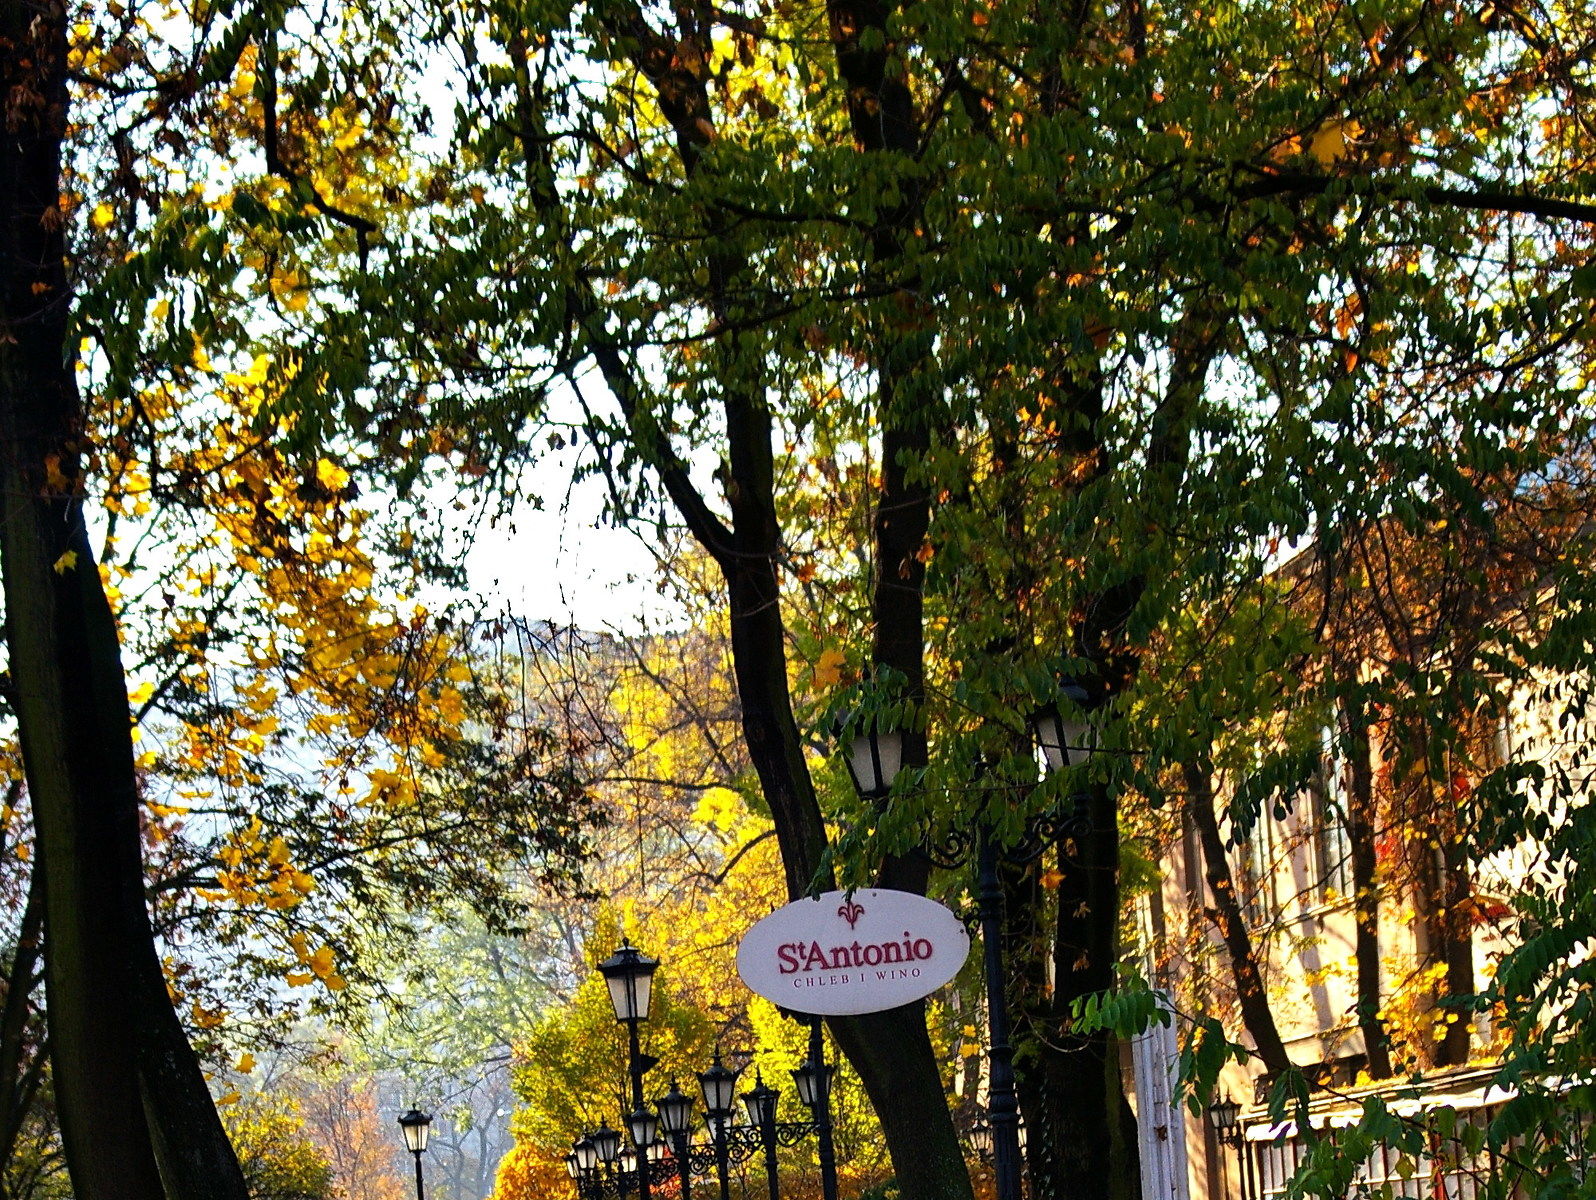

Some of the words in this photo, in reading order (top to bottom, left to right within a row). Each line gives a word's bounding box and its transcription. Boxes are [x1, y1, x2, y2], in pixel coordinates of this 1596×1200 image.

[793, 975, 850, 988] CHLEB
[860, 973, 866, 982] I
[875, 968, 921, 980] WINO
